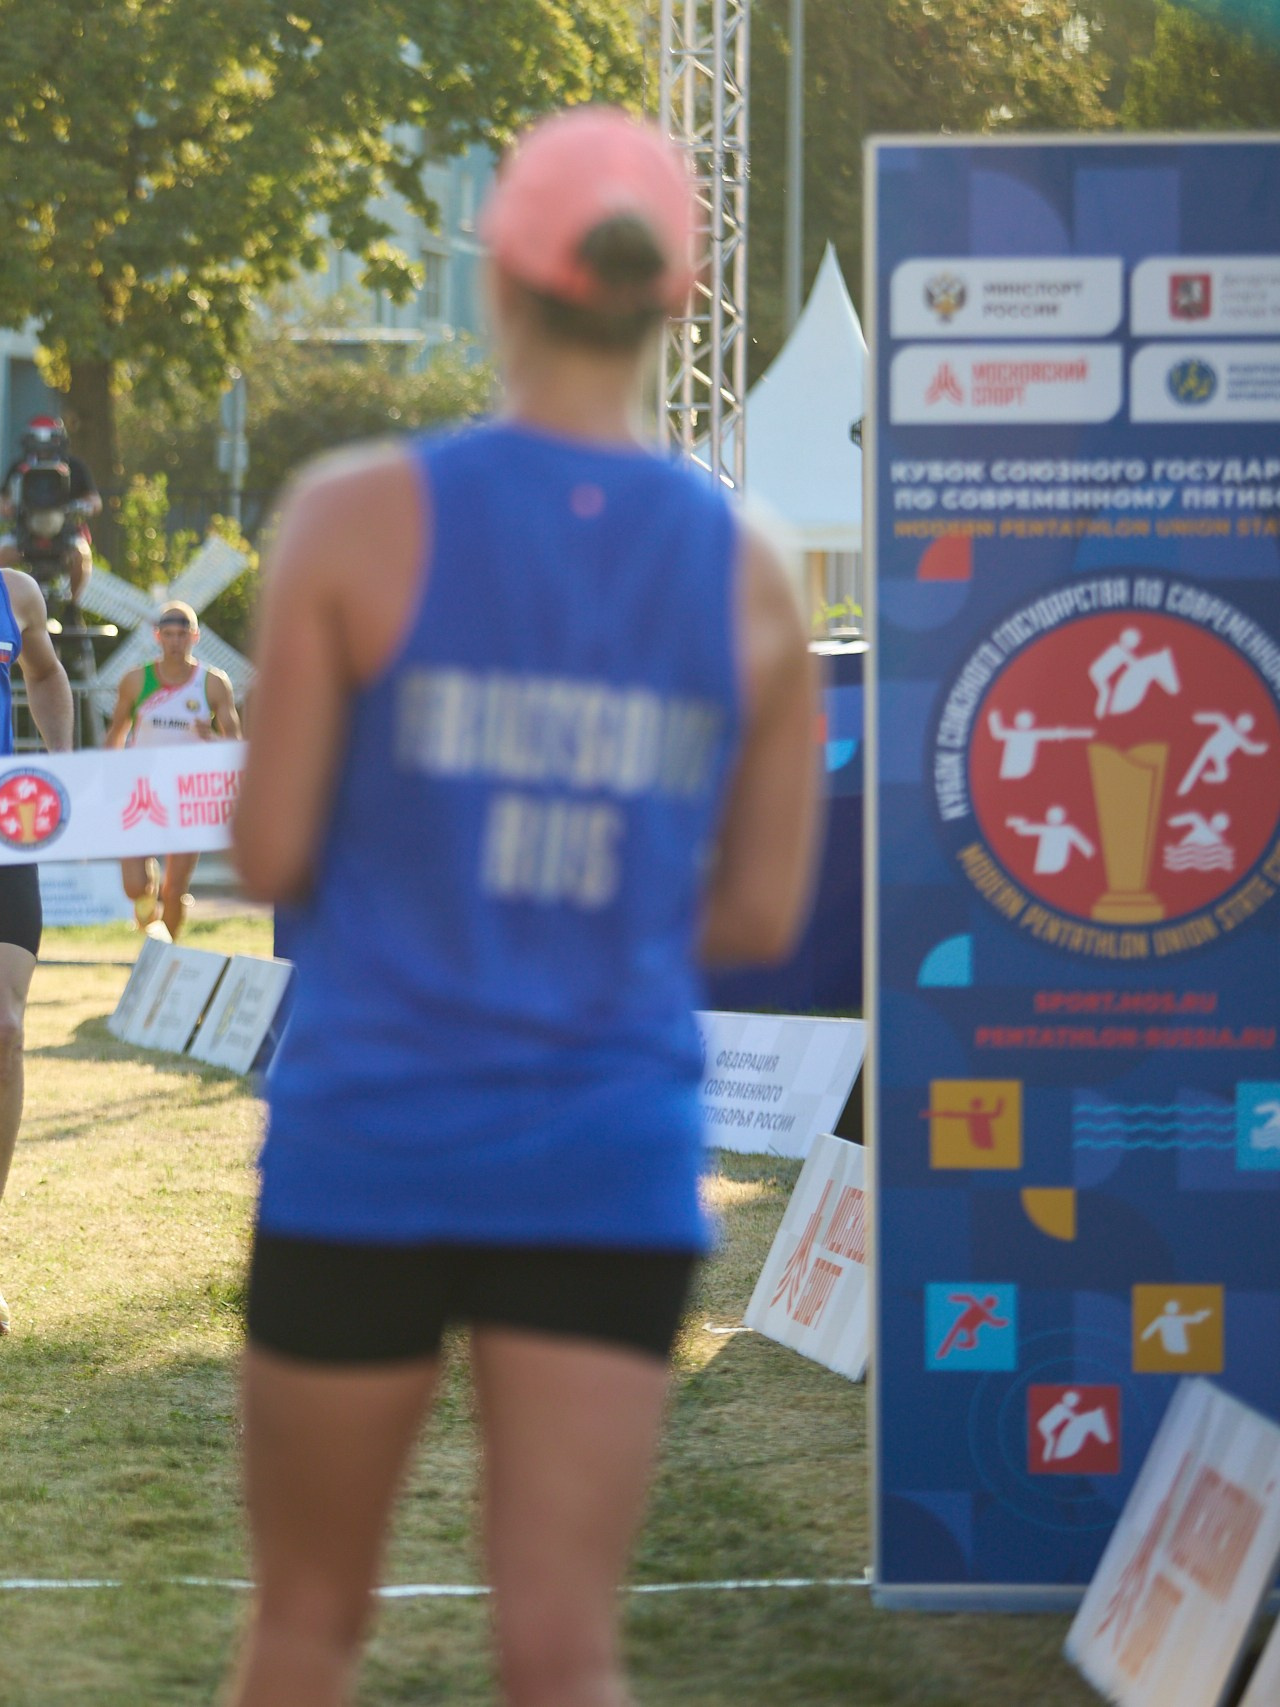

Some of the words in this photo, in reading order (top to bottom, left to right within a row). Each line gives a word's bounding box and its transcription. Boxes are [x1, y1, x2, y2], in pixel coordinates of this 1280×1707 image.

[983, 281, 1083, 298] МИНСПОРТ
[983, 303, 1060, 319] РОССИИ
[972, 355, 1089, 384] МОСКОВСКИЙ
[972, 386, 1026, 406] СПОРТ
[890, 461, 986, 483] КУБОК
[990, 460, 1146, 483] СОЮЗНОГО
[894, 487, 937, 510] ПО
[941, 487, 1175, 510] СОВРЕМЕННОМУ
[1182, 486, 1280, 509] ПЯТИБ
[894, 519, 995, 538] MODERN
[999, 517, 1150, 538] PENTATHLON
[1155, 518, 1231, 537] UNION
[991, 577, 1129, 654] ГОСУДАРСТВА
[1132, 577, 1164, 608] ПО
[177, 769, 240, 797] МОСК
[179, 799, 232, 827] СПОР
[1152, 915, 1218, 957] UNION
[716, 1050, 780, 1074] ФЕДЕРАЦИЯ
[704, 1078, 783, 1103] СОВРЕМЕННОГО
[754, 1112, 796, 1133] РОССИИ
